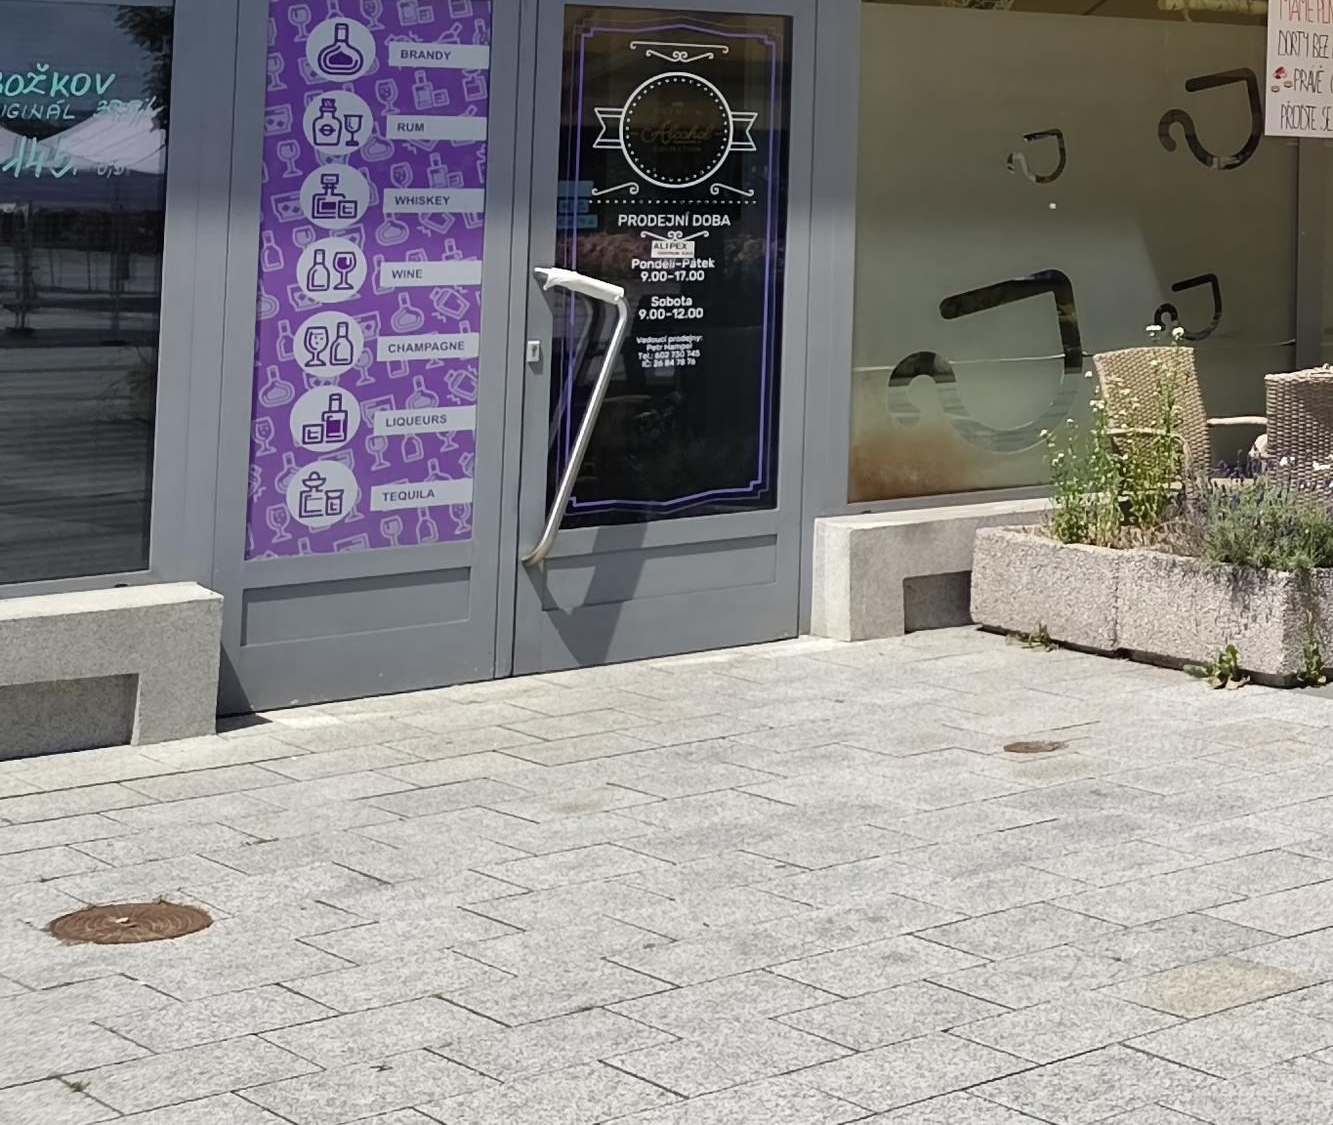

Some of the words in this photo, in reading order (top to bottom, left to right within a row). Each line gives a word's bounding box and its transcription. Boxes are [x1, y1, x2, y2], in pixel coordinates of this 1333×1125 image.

[1278, 30, 1309, 57] DORTY
[1312, 34, 1329, 59] BEZ
[400, 49, 452, 61] BRANDY
[1321, 106, 1333, 131] SE
[397, 122, 425, 132] RUM
[394, 195, 450, 206] WHISKEY
[618, 211, 689, 227] PRODEJNÍ
[692, 214, 731, 226] DOBA
[391, 269, 423, 279] WINE
[640, 271, 705, 282] 9.00-17.00
[651, 295, 693, 307] Sobota
[638, 308, 704, 320] 9.00-12.00
[388, 340, 465, 353] CHAMPAGNE
[385, 414, 448, 427] LIQUEURS
[382, 489, 435, 503] TEQUILA
